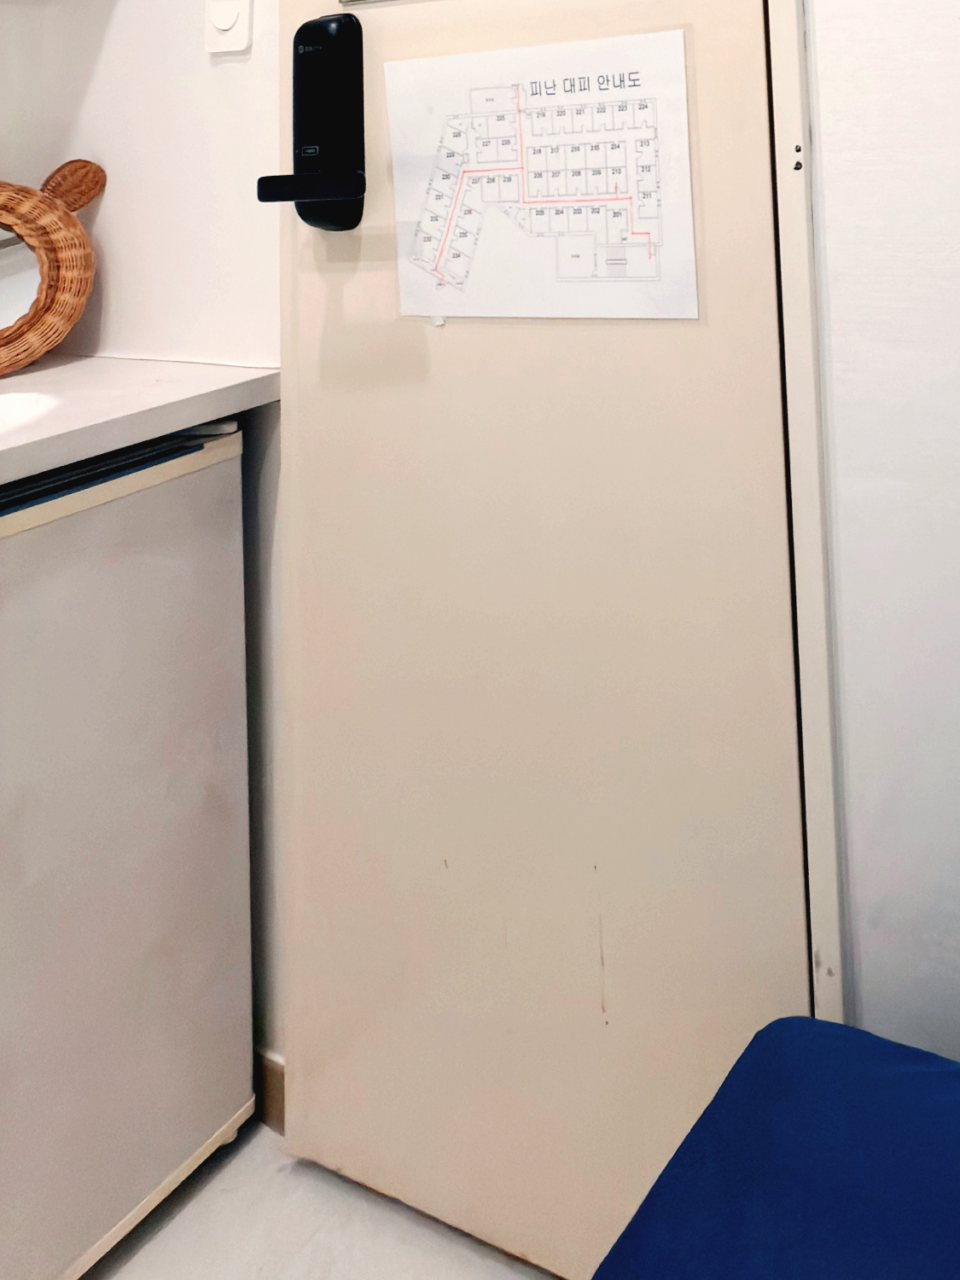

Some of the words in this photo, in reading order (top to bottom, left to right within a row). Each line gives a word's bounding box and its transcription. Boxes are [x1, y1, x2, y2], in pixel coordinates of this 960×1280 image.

[529, 79, 557, 96] 피난
[563, 76, 590, 93] 대피
[597, 72, 641, 91] 안내도
